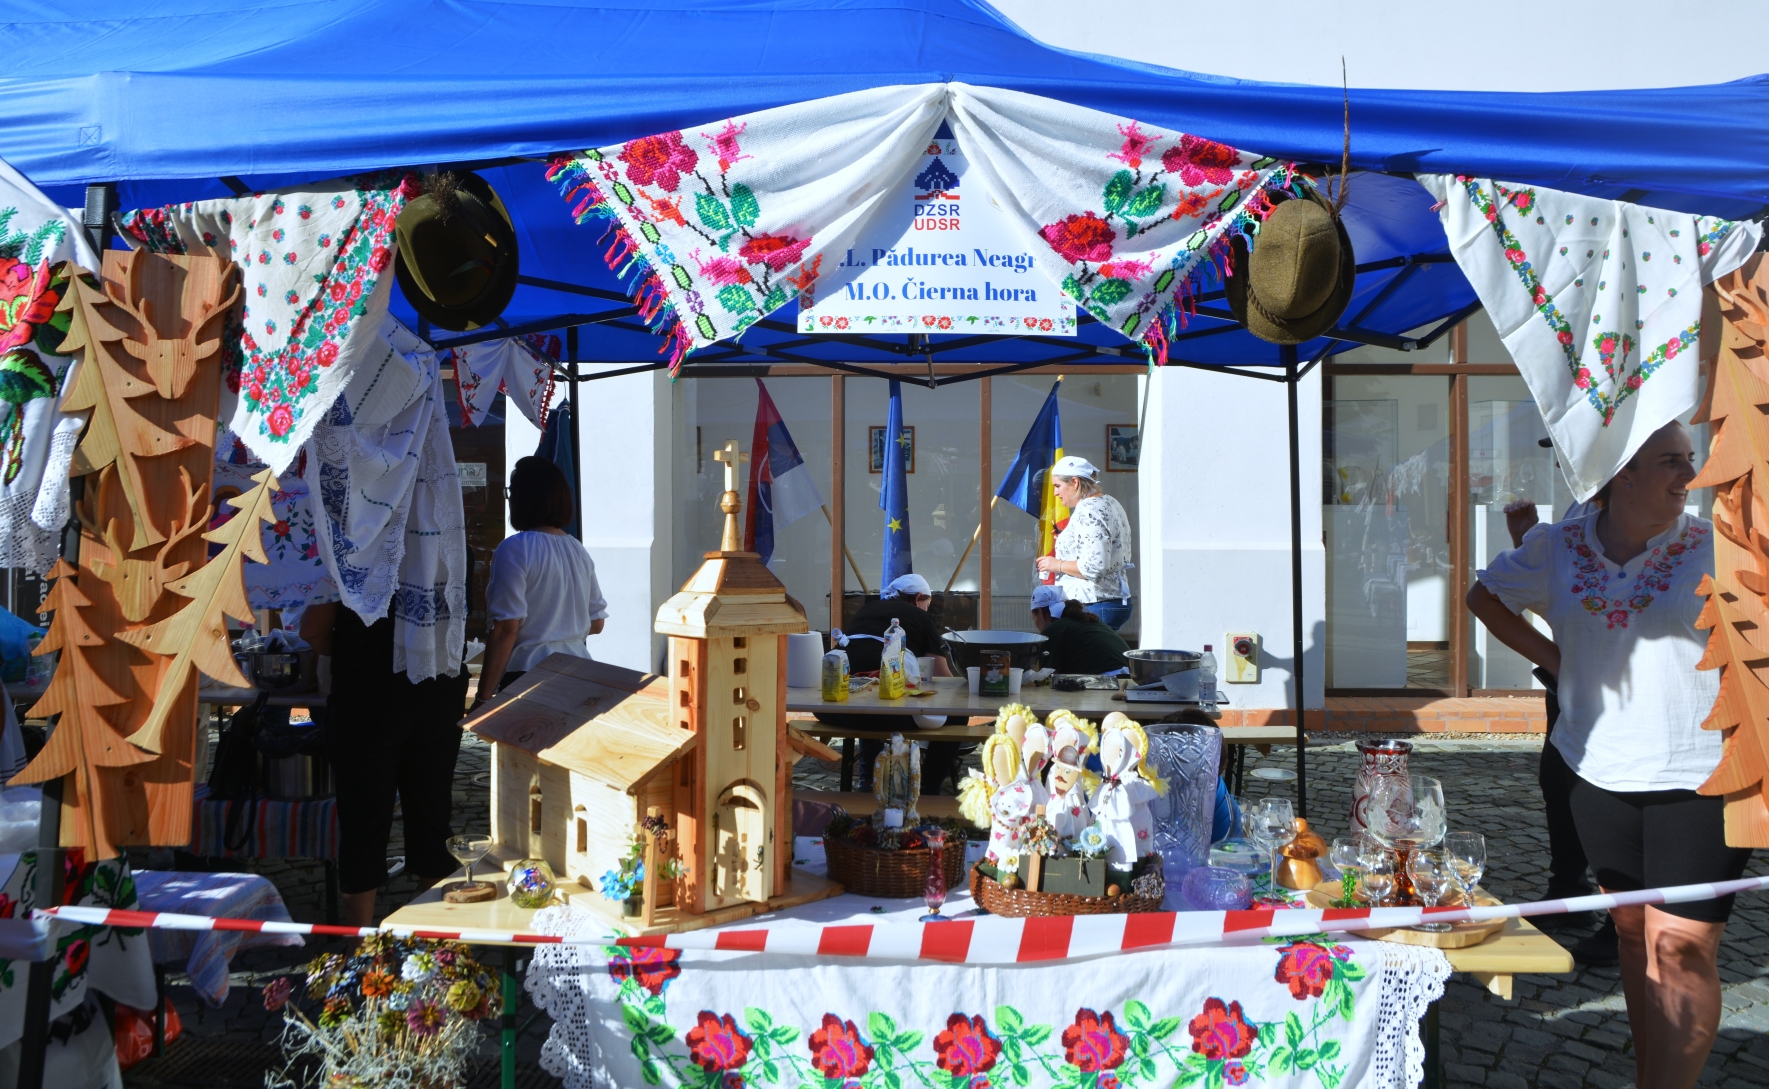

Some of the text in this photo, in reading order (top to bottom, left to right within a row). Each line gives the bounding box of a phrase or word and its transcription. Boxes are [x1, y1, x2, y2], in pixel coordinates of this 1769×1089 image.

[914, 204, 960, 217] DZSR
[914, 218, 961, 231] UDSR
[839, 247, 1037, 274] .L. Pădurea Neagr
[844, 276, 1039, 302] M.O. Čierna hora
